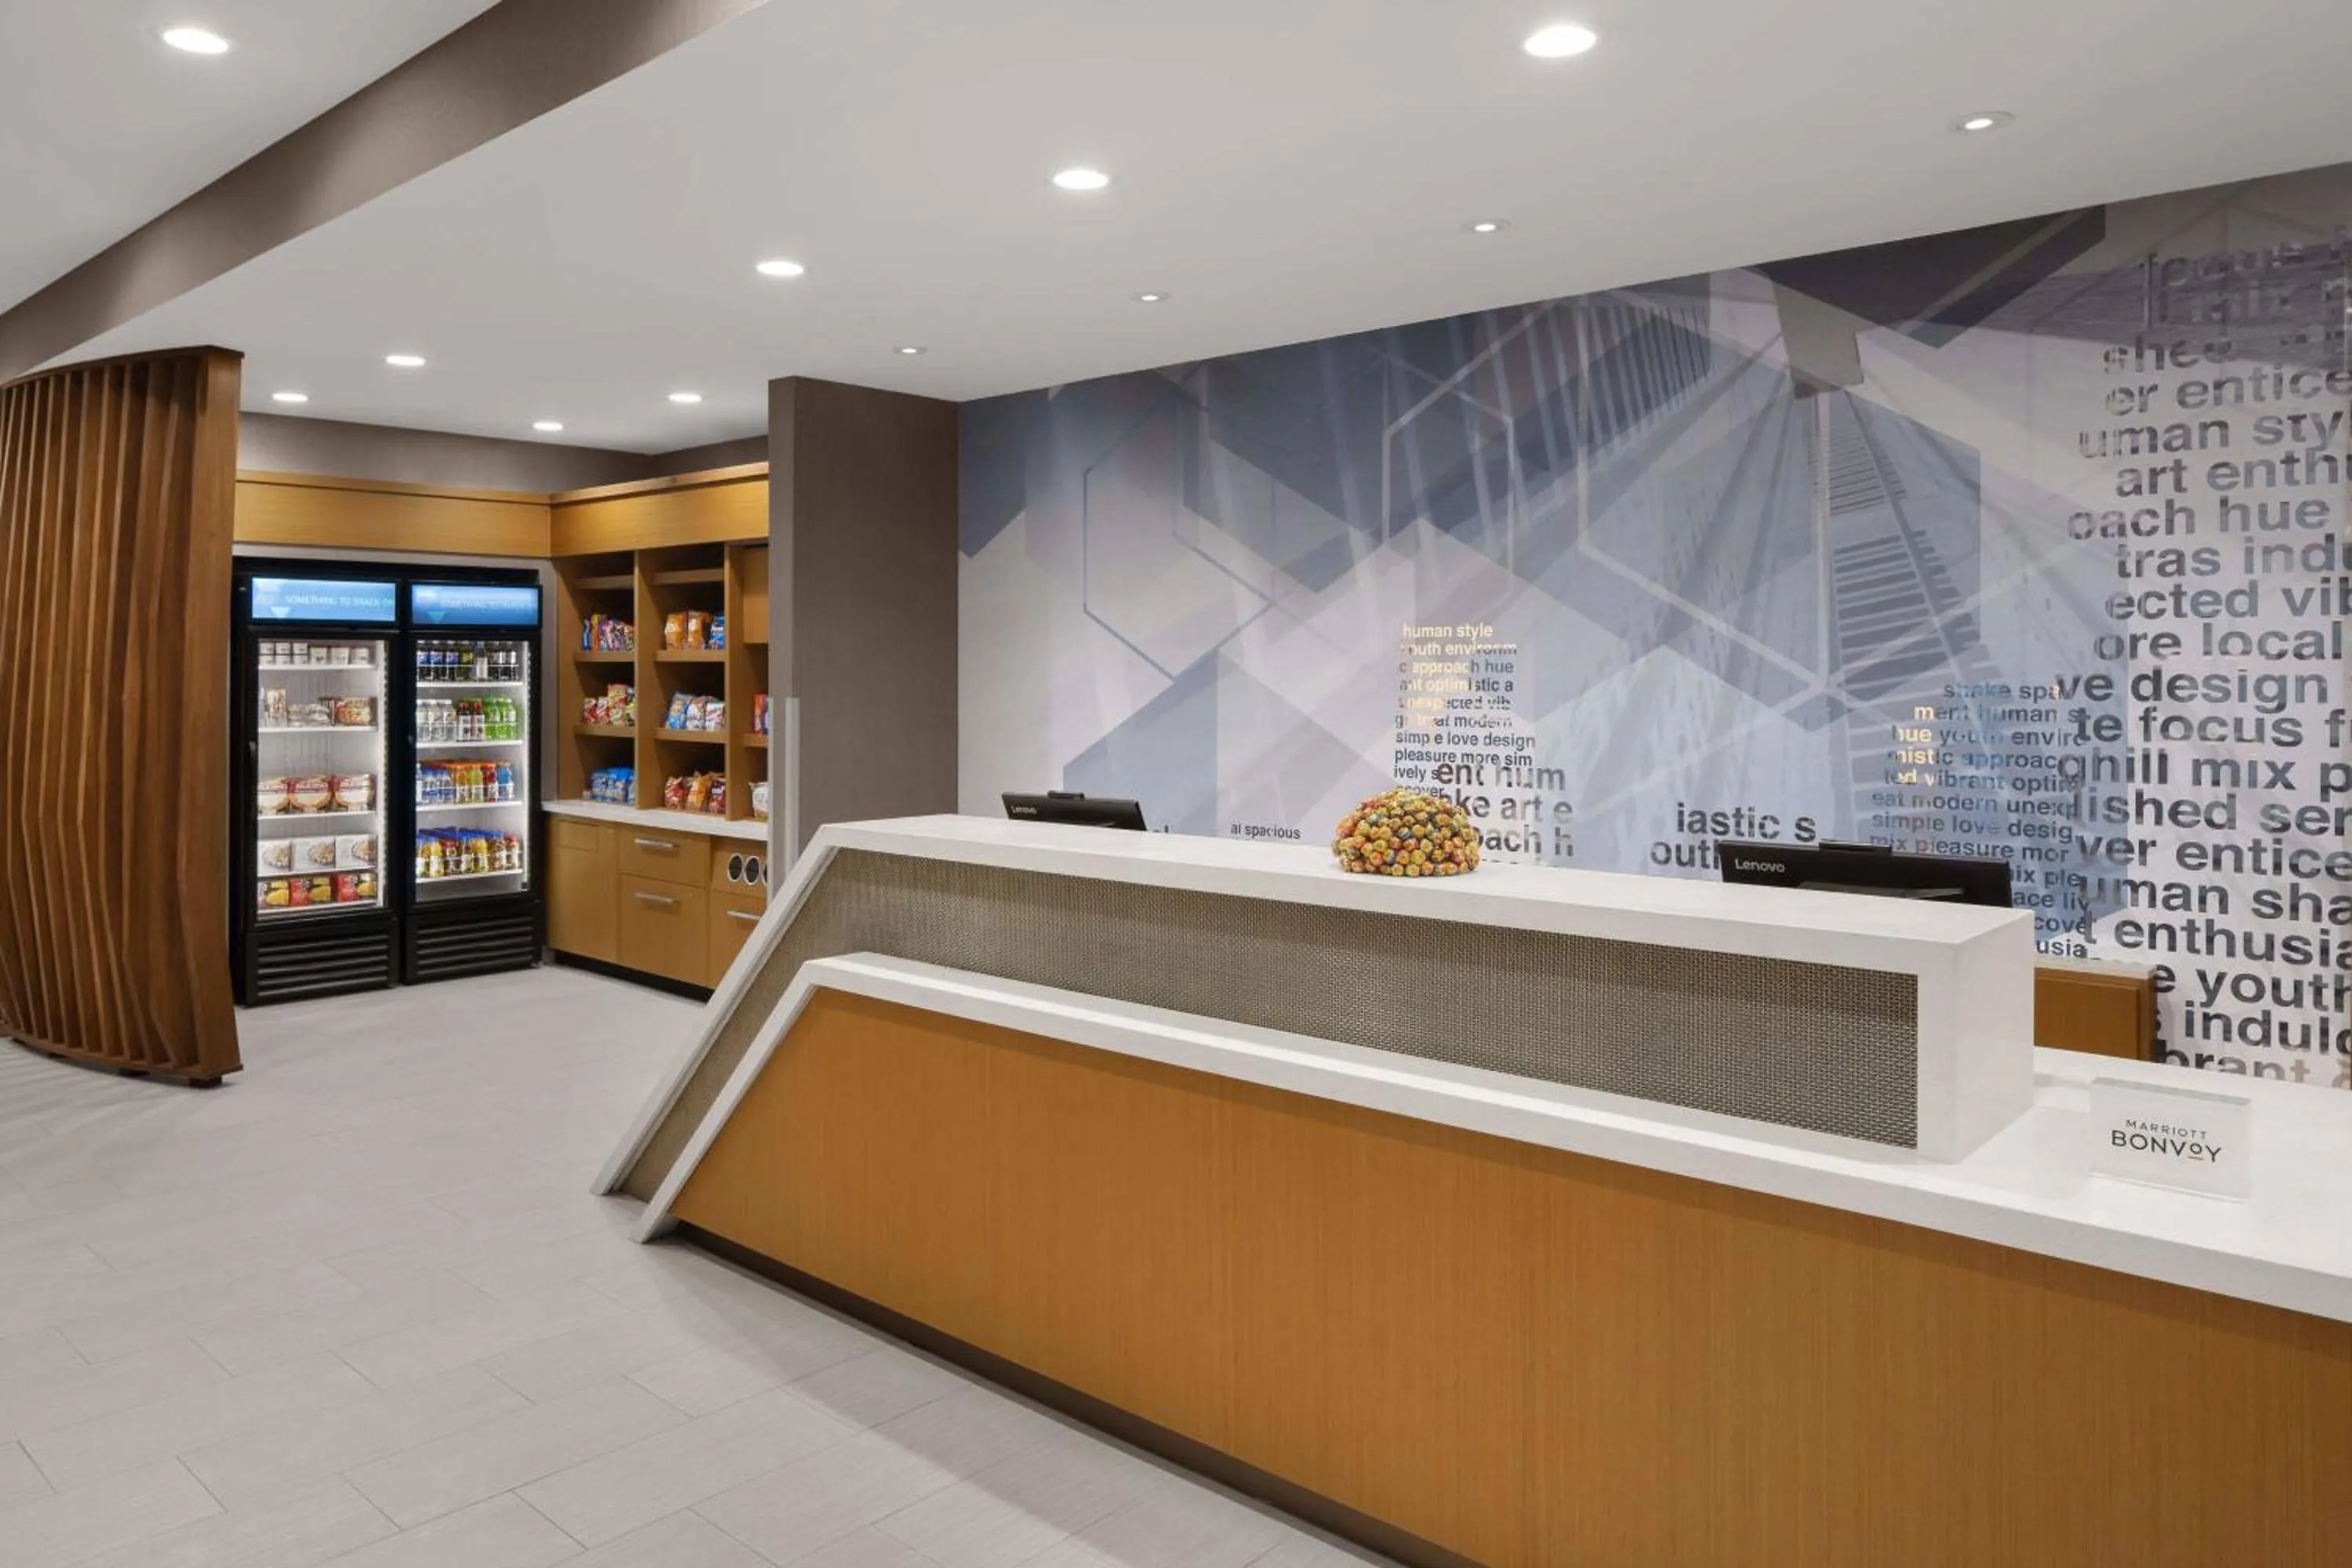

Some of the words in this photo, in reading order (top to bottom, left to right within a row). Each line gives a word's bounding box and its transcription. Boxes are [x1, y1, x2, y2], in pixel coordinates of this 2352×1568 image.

[2105, 381, 2158, 416] er
[2078, 419, 2230, 458] uman
[2252, 401, 2352, 452] sty
[2115, 458, 2188, 497] art
[2206, 447, 2352, 492] enth
[2067, 498, 2195, 541] oach
[2219, 495, 2331, 533] hue
[2115, 542, 2222, 579] tras
[2105, 579, 2259, 620] ected
[1403, 622, 1453, 638] human
[1456, 622, 1494, 642] style
[2094, 630, 2182, 660] ore
[2201, 621, 2343, 660] local
[1484, 658, 1515, 673] hue
[1504, 680, 1514, 692] a
[2130, 666, 2328, 714] design
[1395, 731, 1443, 749] simpe
[1446, 731, 1479, 746] love
[1483, 731, 1537, 753] design
[2078, 706, 2123, 743] te
[2138, 706, 2304, 748] focus
[1394, 746, 1457, 764] pleasure
[1461, 750, 1501, 766] more
[1504, 750, 1533, 768] sim
[1394, 764, 1427, 783] ively
[1437, 763, 1485, 786] ent
[2192, 757, 2297, 790] mix
[1500, 795, 1543, 822] art
[1676, 802, 1780, 840] iastic
[1871, 812, 1945, 833] simple
[1952, 815, 2000, 834] love
[2007, 820, 2073, 844] desig
[1734, 858, 1786, 873] Lenovo
[1915, 836, 2015, 859] pleasure
[2021, 844, 2070, 864] mor
[2076, 835, 2158, 867] ver
[2125, 1119, 2208, 1140] MARRIOTT
[2111, 1129, 2222, 1163] BONVOY
